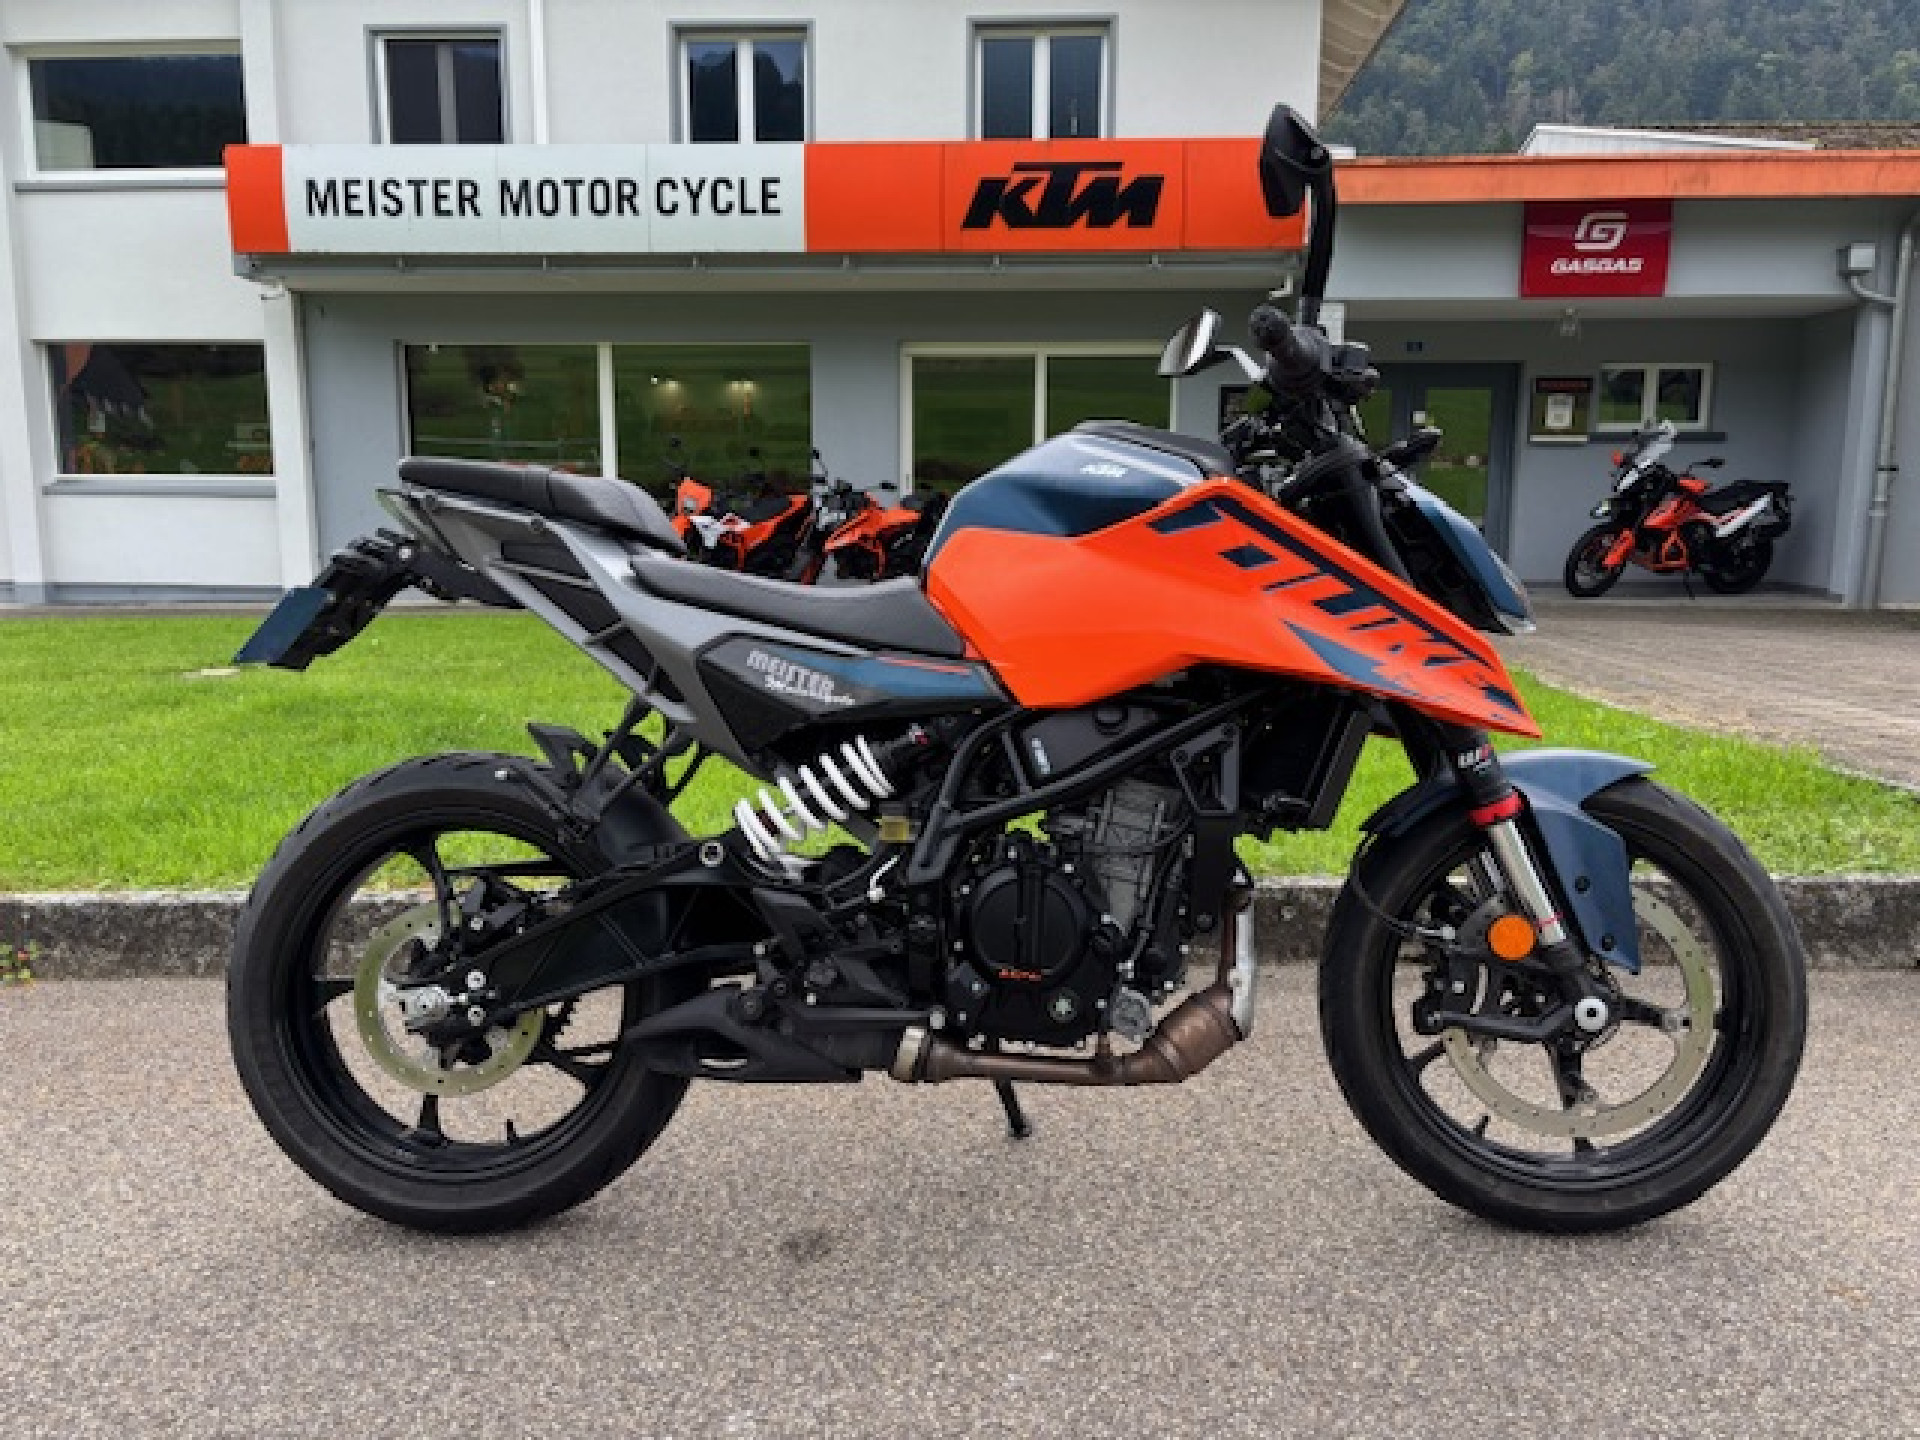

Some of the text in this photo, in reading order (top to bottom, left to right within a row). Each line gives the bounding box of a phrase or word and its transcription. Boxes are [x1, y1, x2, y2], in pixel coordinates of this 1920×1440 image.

[305, 178, 782, 218] MEISTER MOTOR CYCLE
[962, 161, 1164, 230] KTM
[1550, 258, 1644, 275] GASGAS
